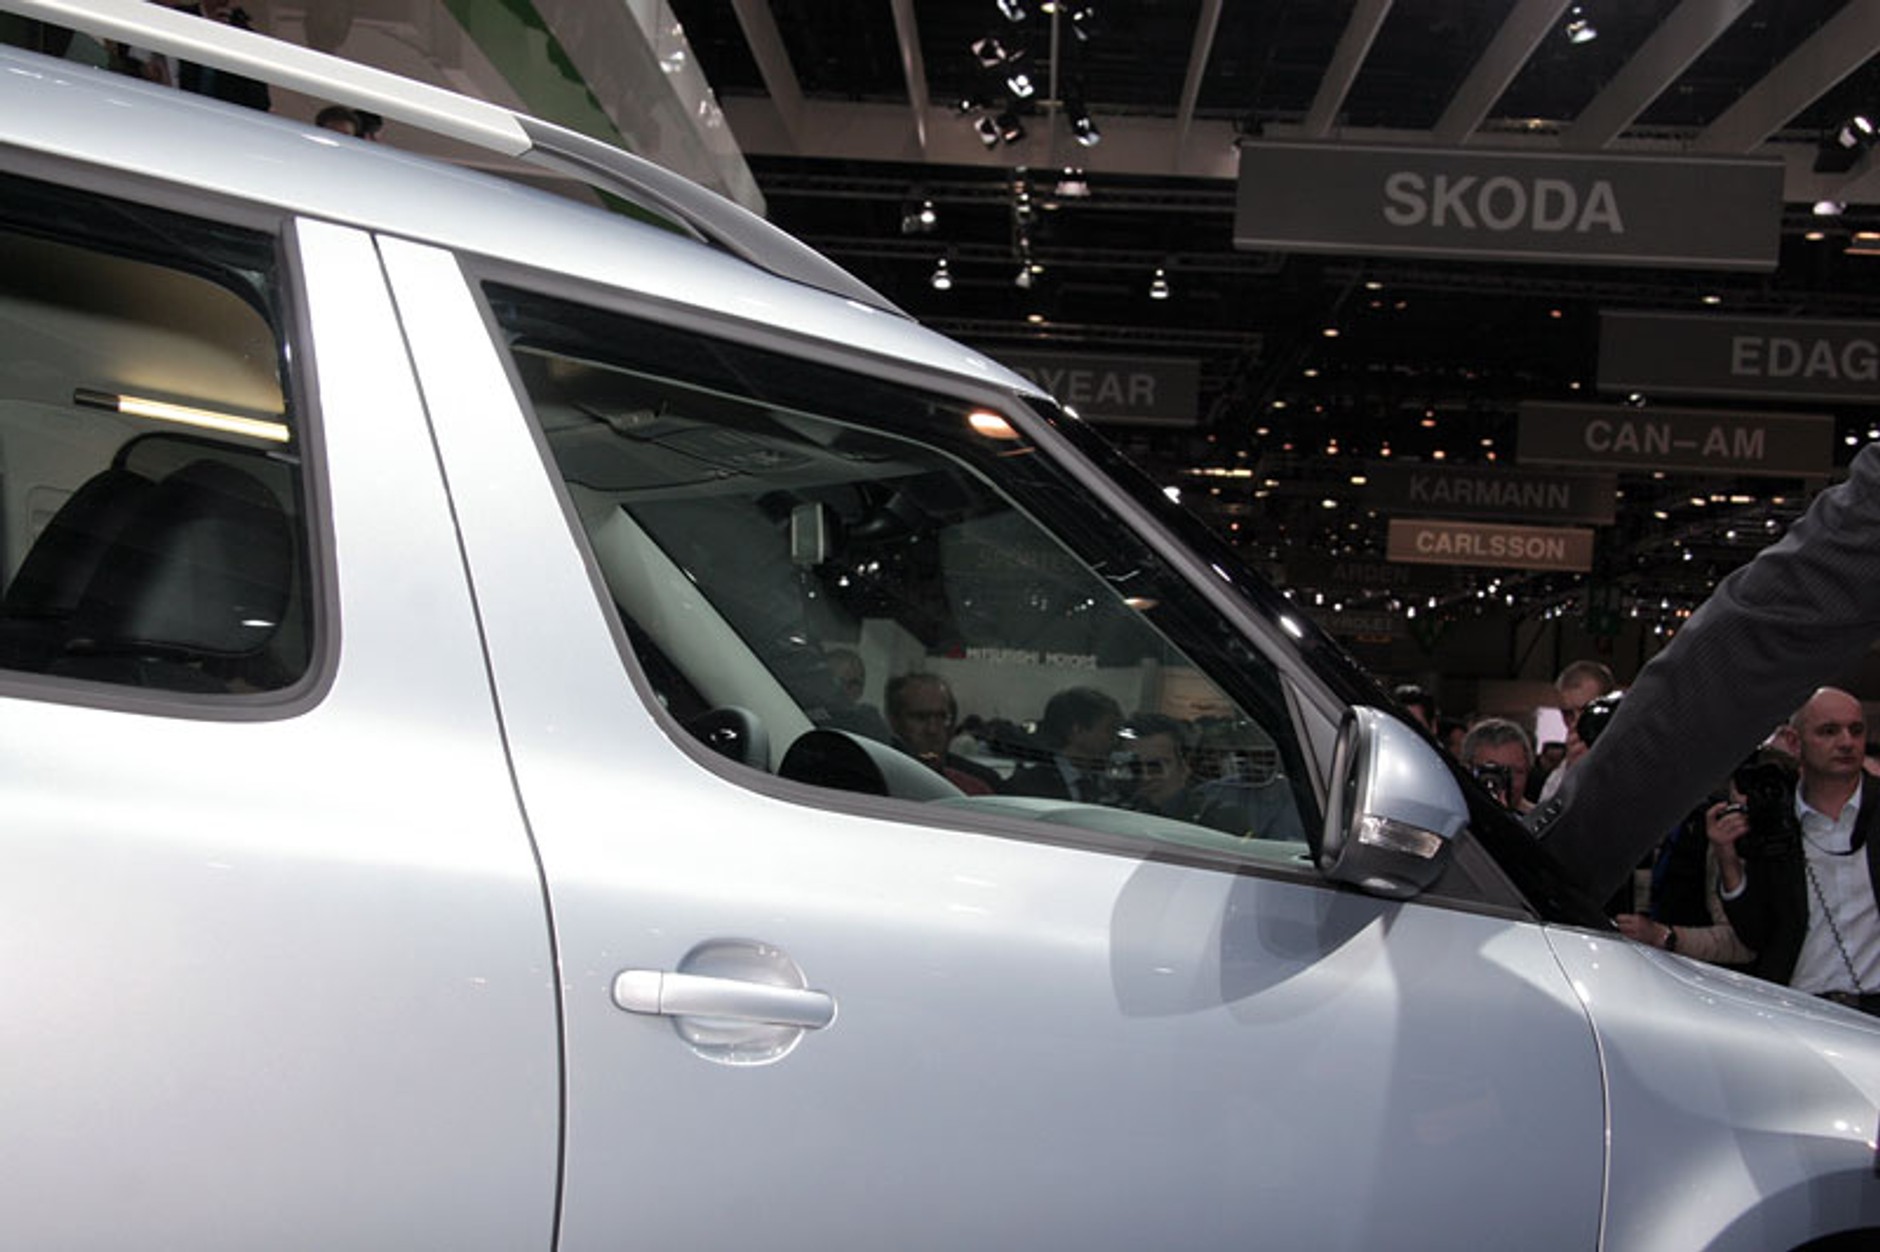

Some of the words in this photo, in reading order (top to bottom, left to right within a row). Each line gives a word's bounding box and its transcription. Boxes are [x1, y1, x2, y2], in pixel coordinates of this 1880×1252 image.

[1383, 171, 1625, 234] SKODA
[1730, 336, 1880, 381] EDAG
[1018, 366, 1156, 407] YEAR
[1408, 473, 1570, 510] KARMANN
[1415, 530, 1565, 560] CARLSSON
